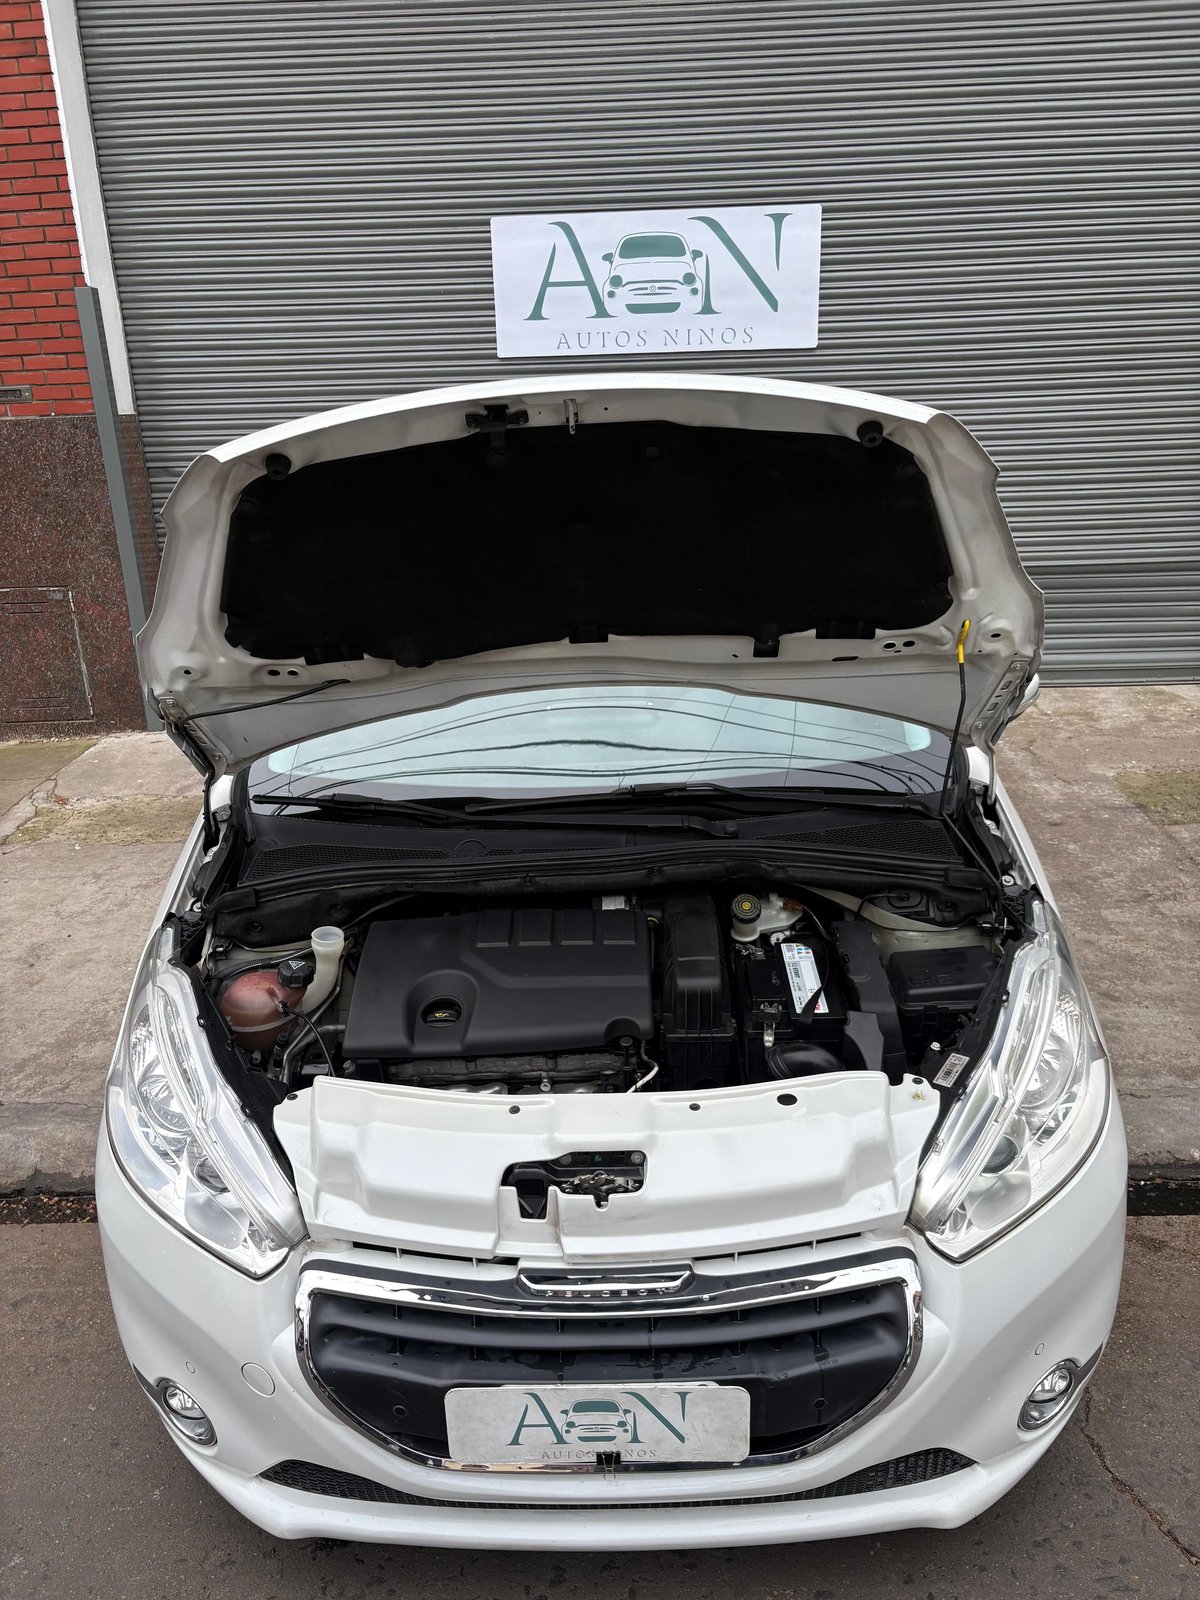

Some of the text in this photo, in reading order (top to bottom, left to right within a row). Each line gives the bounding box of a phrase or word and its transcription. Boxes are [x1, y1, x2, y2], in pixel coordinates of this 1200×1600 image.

[556, 326, 754, 350] AUTOS NINOS
[541, 1449, 595, 1460] AUTOS
